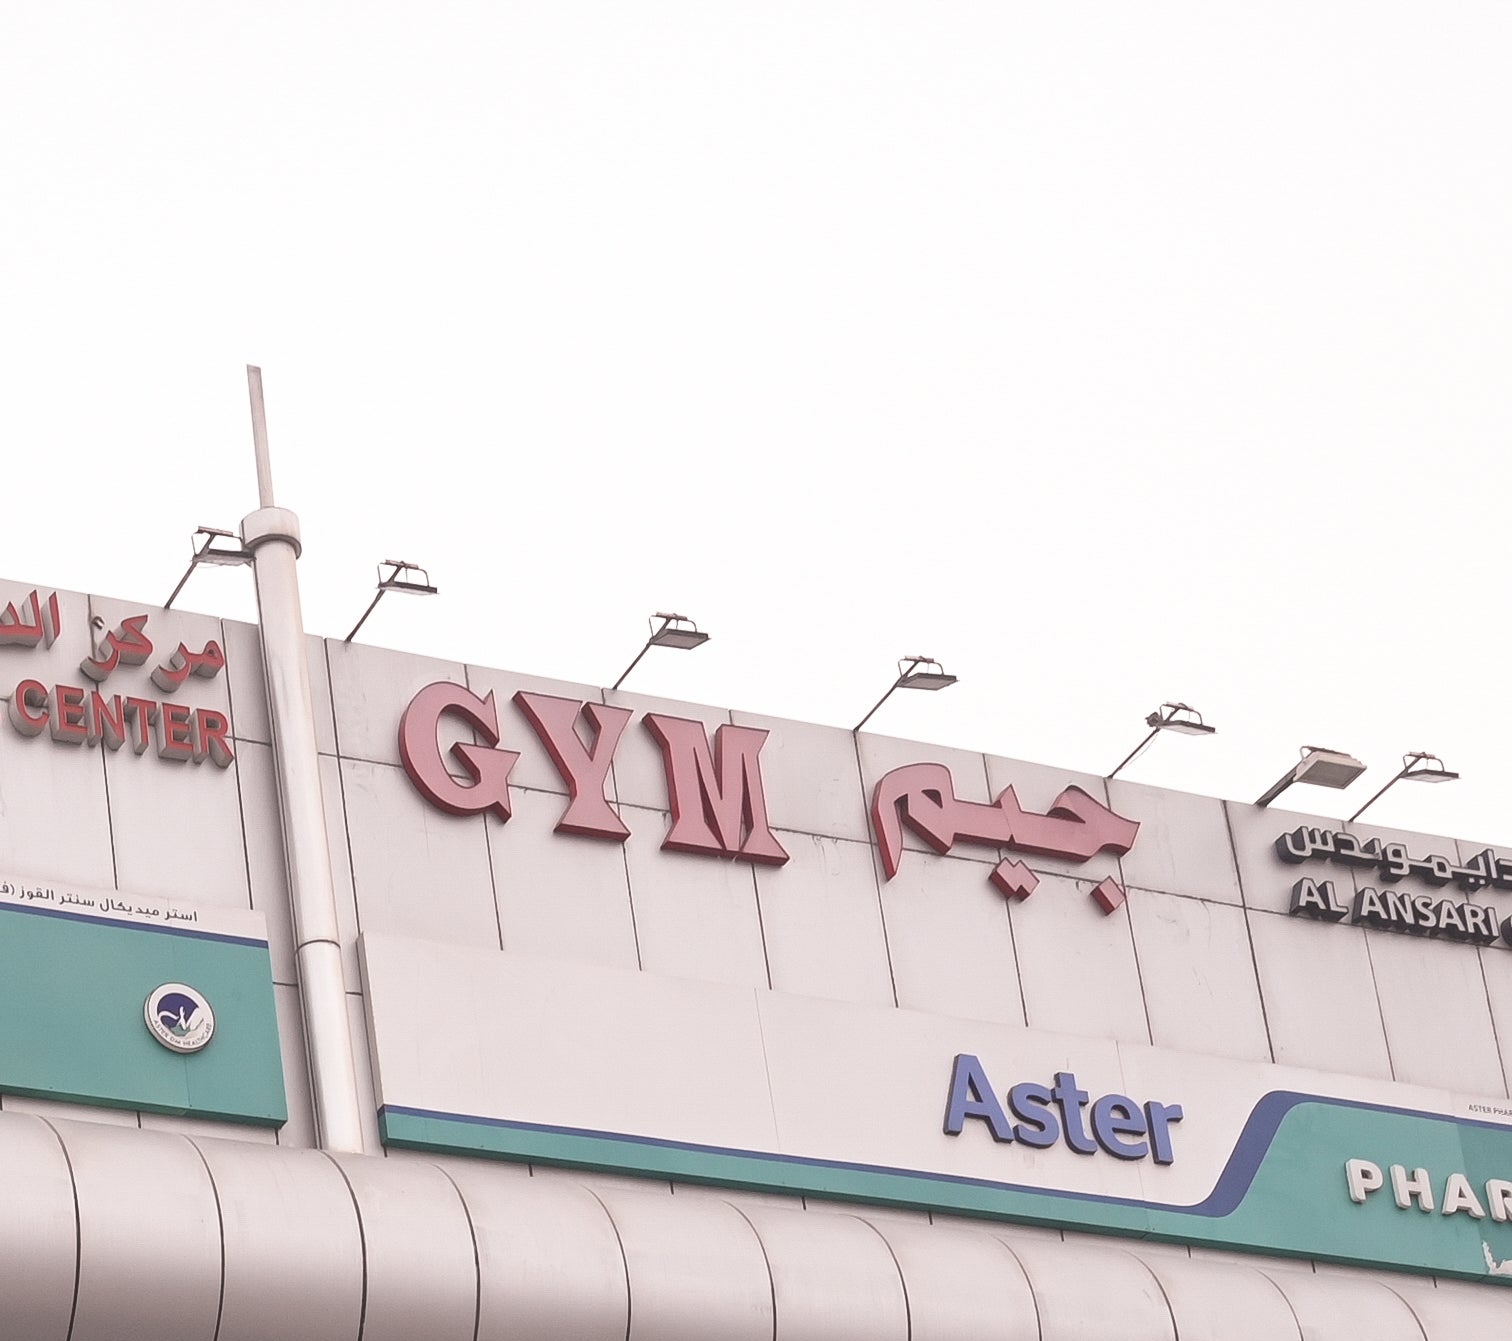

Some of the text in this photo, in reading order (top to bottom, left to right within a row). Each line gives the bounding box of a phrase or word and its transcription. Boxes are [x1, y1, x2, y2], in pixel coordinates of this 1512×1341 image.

[80, 613, 226, 693] مركز
[10, 677, 235, 771] CENTER
[397, 679, 791, 868] GYM
[869, 760, 1142, 917] جيم
[1289, 875, 1349, 923] AL
[1351, 885, 1502, 946] ANSARI
[942, 1051, 1185, 1166] Aster
